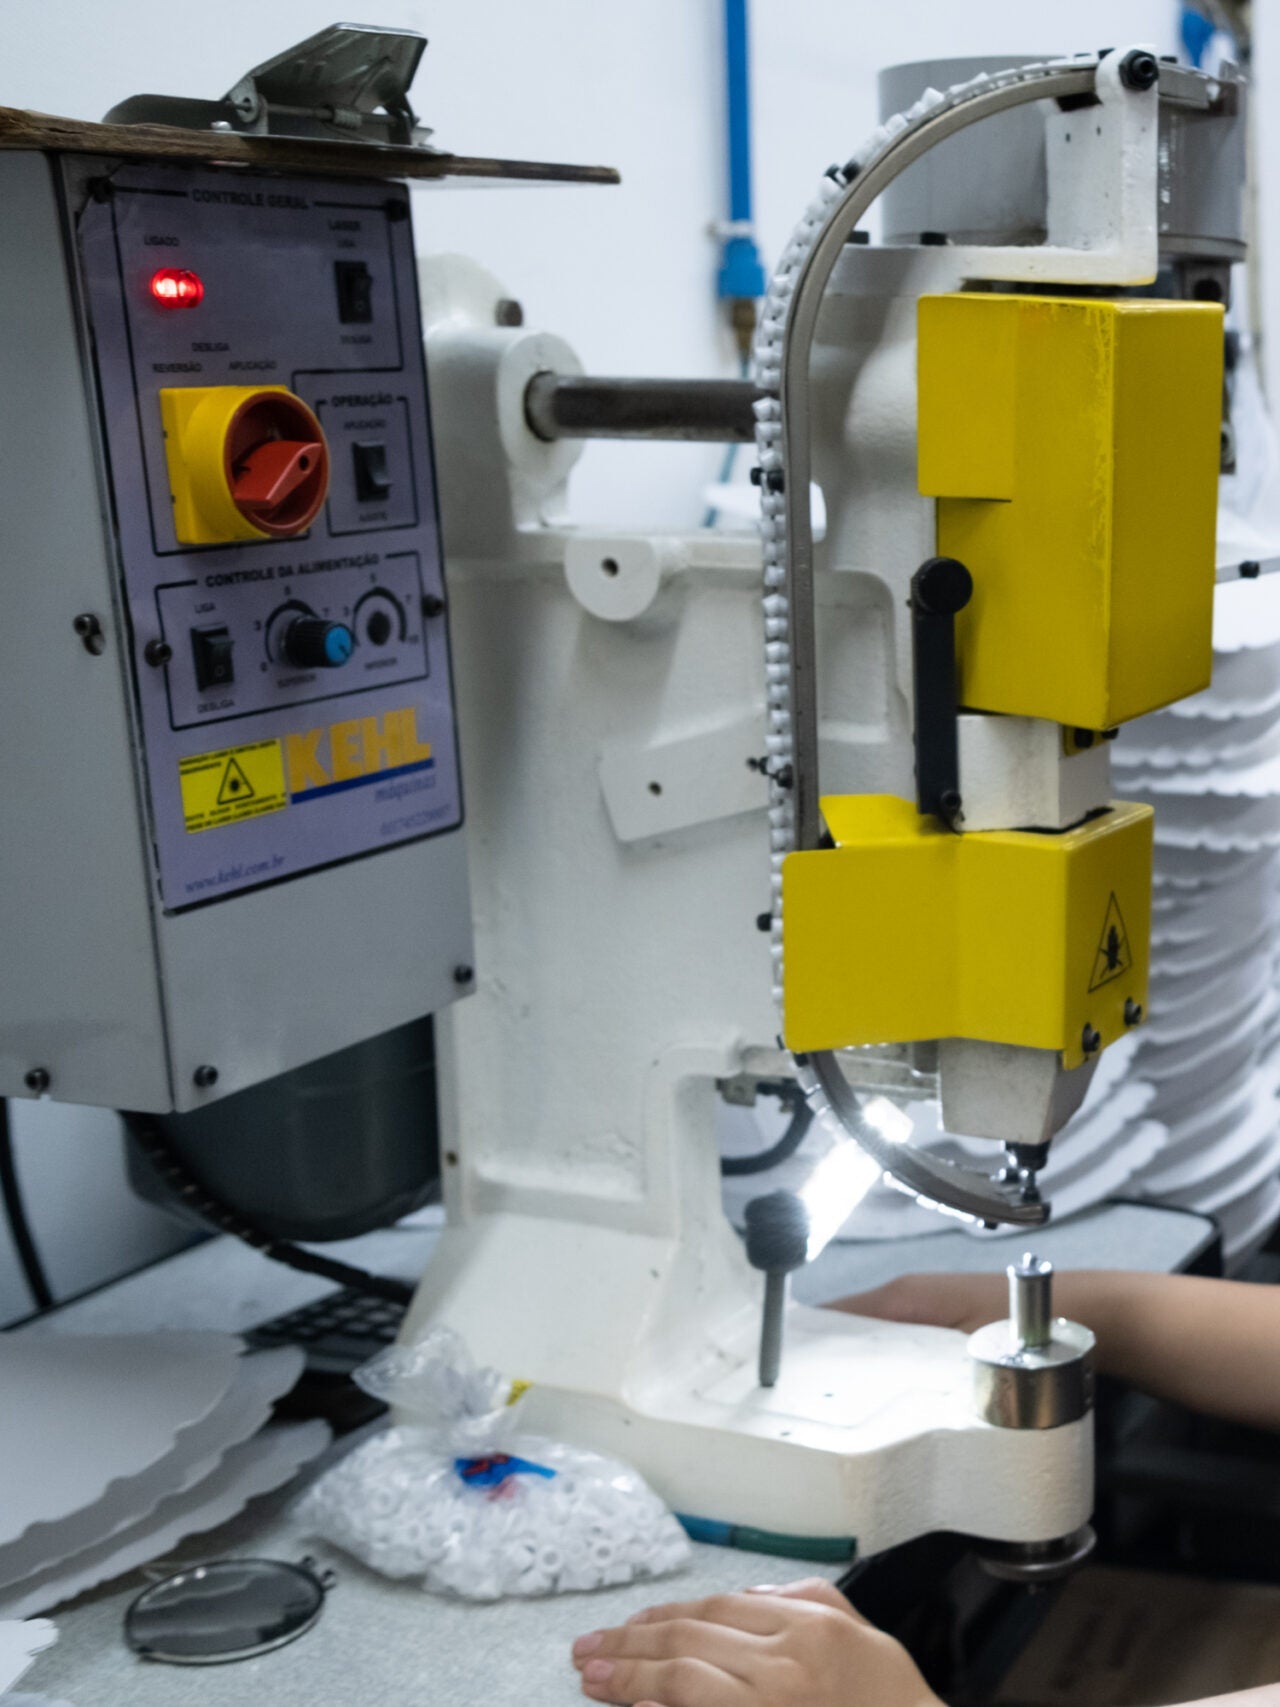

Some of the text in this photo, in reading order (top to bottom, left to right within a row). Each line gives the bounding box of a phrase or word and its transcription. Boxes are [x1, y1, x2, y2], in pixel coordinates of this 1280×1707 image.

[192, 189, 309, 210] CONTROLE GERAL
[144, 235, 180, 247] LIGADO
[191, 342, 230, 353] DESLIGA
[152, 360, 202, 373] REVERSÃO
[229, 358, 277, 372] APLICAÇÃO
[331, 391, 393, 407] OPERAÇÃO
[205, 553, 380, 587] CONTROLE DA ALIMENTAÇÃO
[195, 602, 215, 615] LIGA
[197, 698, 235, 714] DESLIGA
[285, 706, 432, 793] KEHL
[184, 853, 285, 894] www.kehl.com.br
